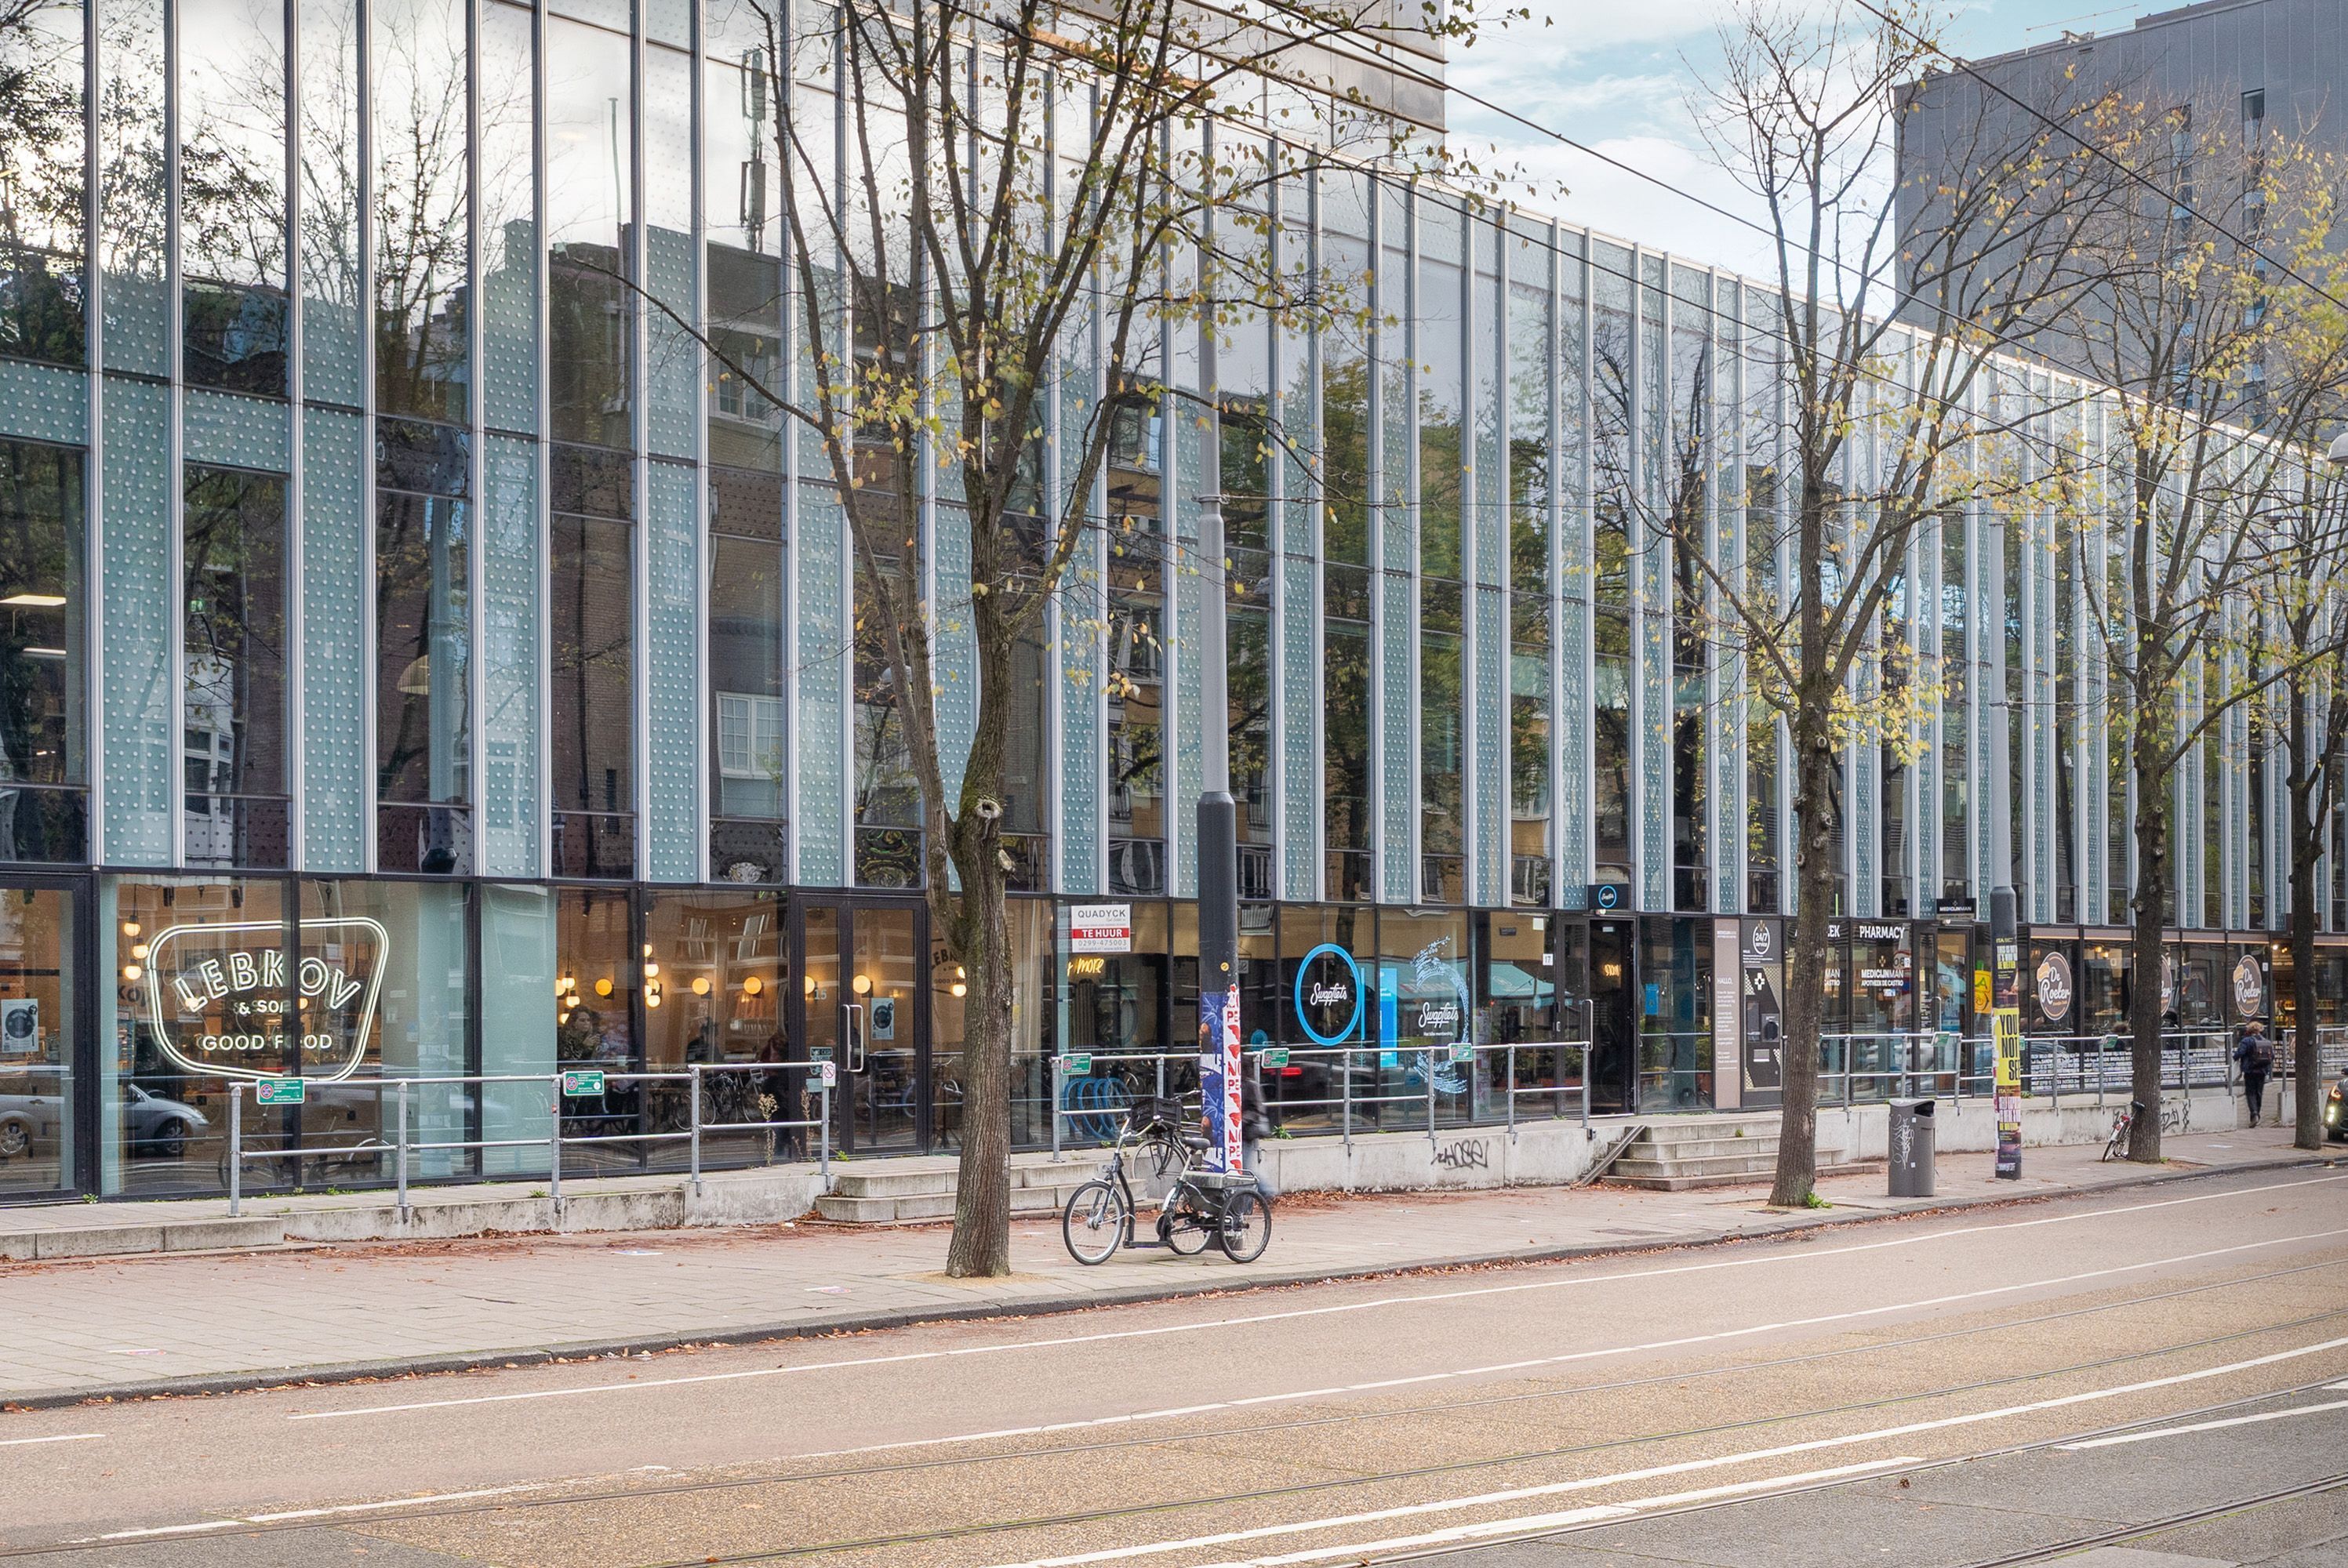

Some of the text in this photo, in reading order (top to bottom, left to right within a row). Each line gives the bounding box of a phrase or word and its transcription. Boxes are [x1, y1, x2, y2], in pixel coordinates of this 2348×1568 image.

[1078, 909, 1126, 918] QUADYCK
[1081, 928, 1123, 938] TE HUUR
[1755, 932, 1768, 942] 24/7
[1859, 925, 1905, 938] PHARMACY
[1076, 958, 1104, 975] more
[174, 949, 362, 1010] LEBKOV
[2048, 967, 2061, 982] De
[815, 989, 827, 1000] 15
[1310, 982, 1348, 1007] Swapfiets
[239, 1001, 251, 1015] &
[1418, 1001, 1459, 1029] Swapfiets
[202, 1034, 333, 1051] GOOD FOD
